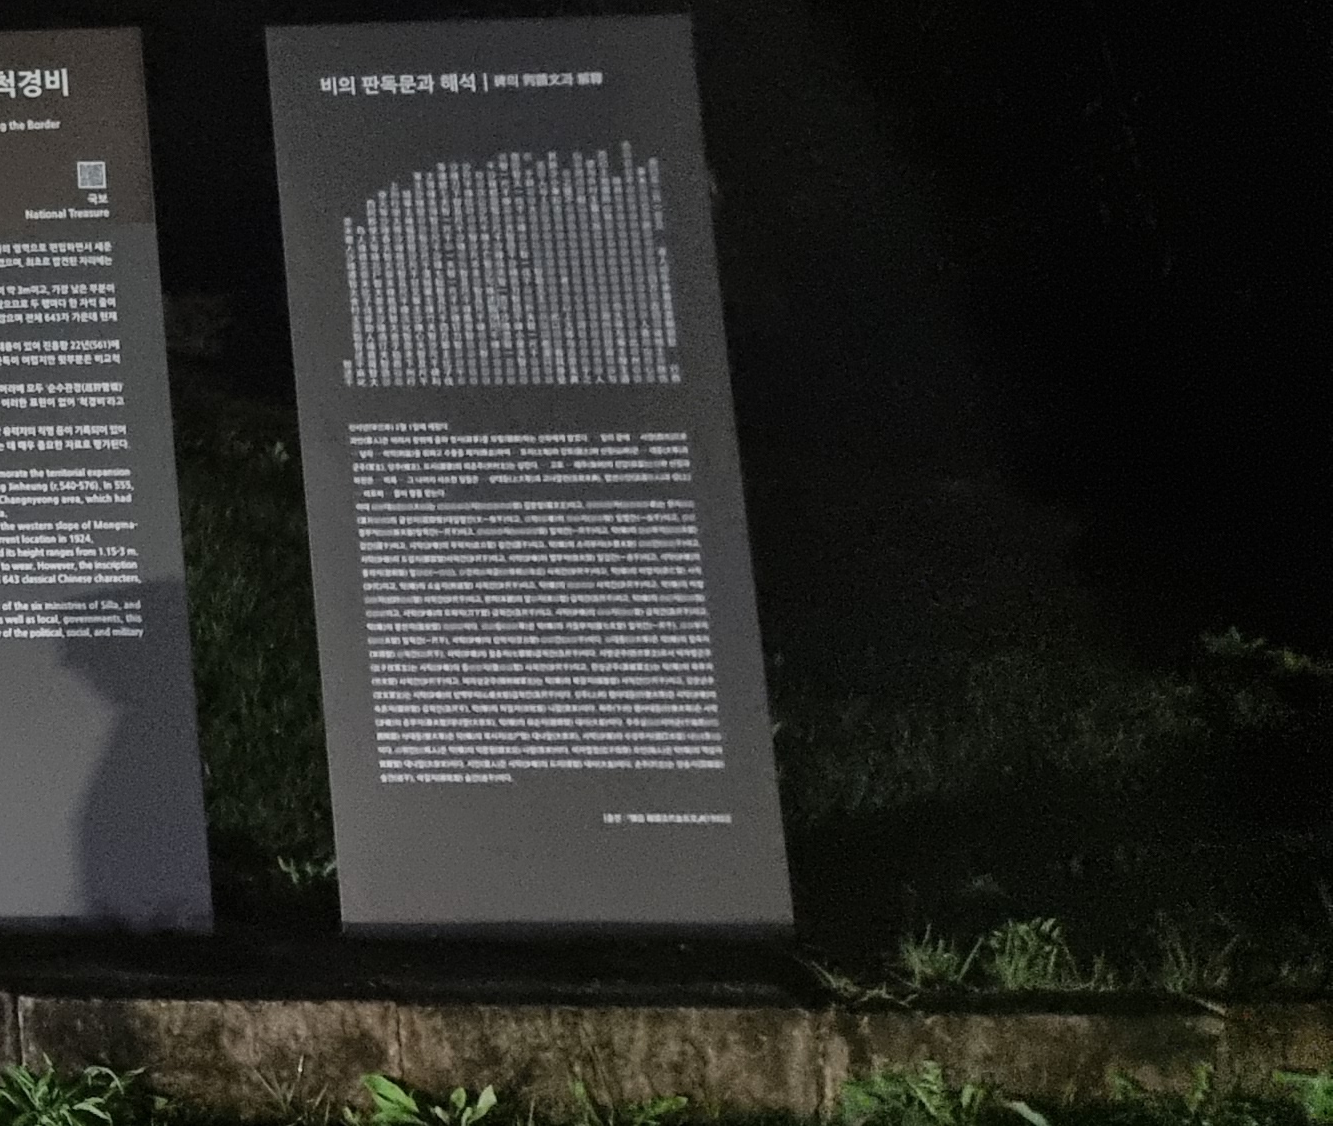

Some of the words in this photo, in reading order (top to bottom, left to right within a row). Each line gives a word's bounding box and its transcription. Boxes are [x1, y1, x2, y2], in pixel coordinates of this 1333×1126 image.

[320, 76, 356, 96] 비의
[362, 74, 435, 95] 판독문과
[440, 73, 477, 93] 해석
[8, 120, 25, 132] the
[27, 119, 61, 131] Border
[24, 208, 67, 220] National
[68, 207, 110, 219] Treasure
[29, 468, 44, 477] the
[45, 468, 85, 477] territorial
[86, 468, 131, 477] expansion
[8, 481, 48, 492] Jinheung
[84, 493, 112, 503] which
[114, 493, 131, 502] had
[0, 521, 15, 530] the
[17, 521, 53, 530] western
[55, 520, 79, 531] slope
[21, 534, 56, 543] location
[2, 574, 19, 583] 643
[57, 573, 92, 583] Chinese
[93, 573, 141, 583] characters,
[13, 601, 28, 610] the
[30, 601, 42, 610] six
[100, 600, 121, 610] Silla,
[123, 600, 141, 609] and
[4, 614, 23, 624] well
[36, 614, 60, 624] local,
[125, 613, 142, 623] this
